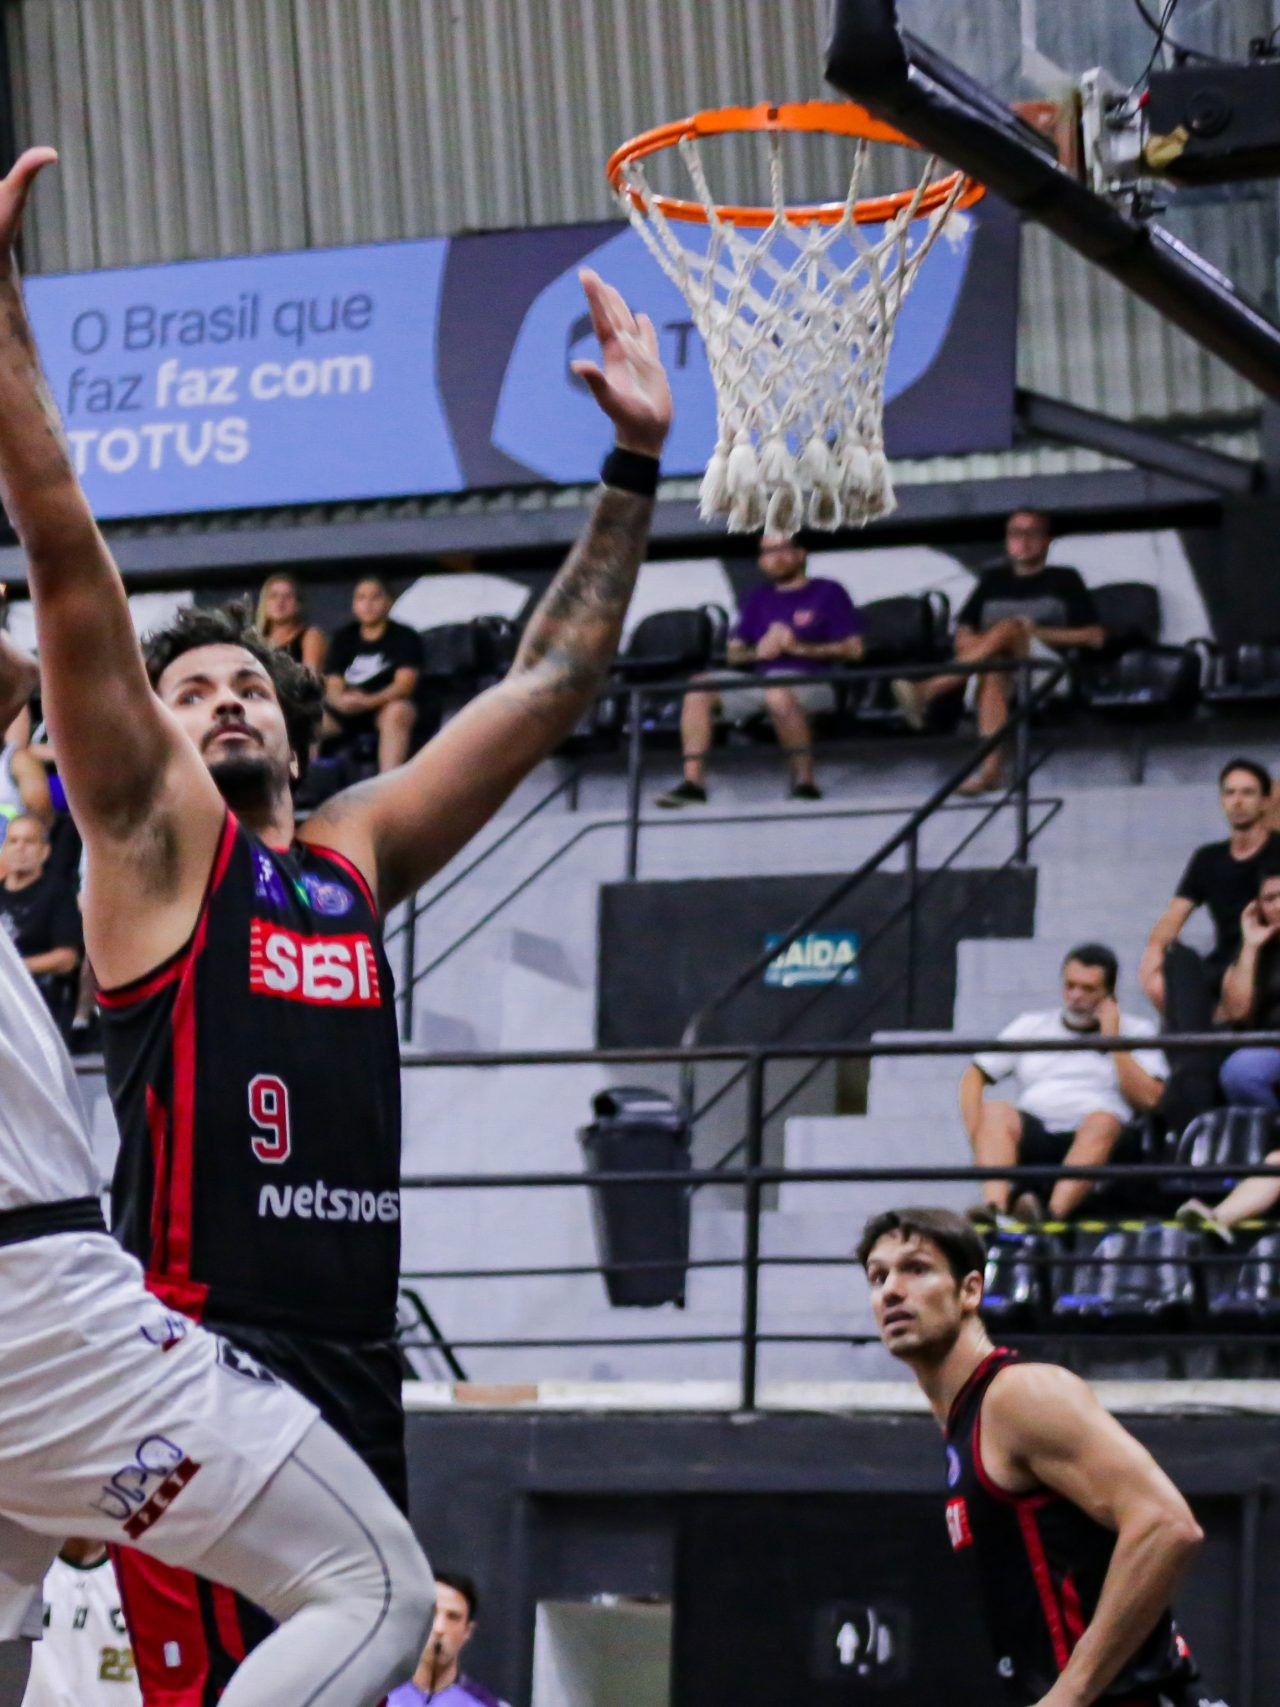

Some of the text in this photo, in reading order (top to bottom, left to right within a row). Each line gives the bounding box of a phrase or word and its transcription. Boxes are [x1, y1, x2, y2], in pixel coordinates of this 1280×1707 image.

[71, 292, 373, 355] O Brasil que
[67, 354, 373, 415] faz faz com
[248, 1073, 291, 1164] 9
